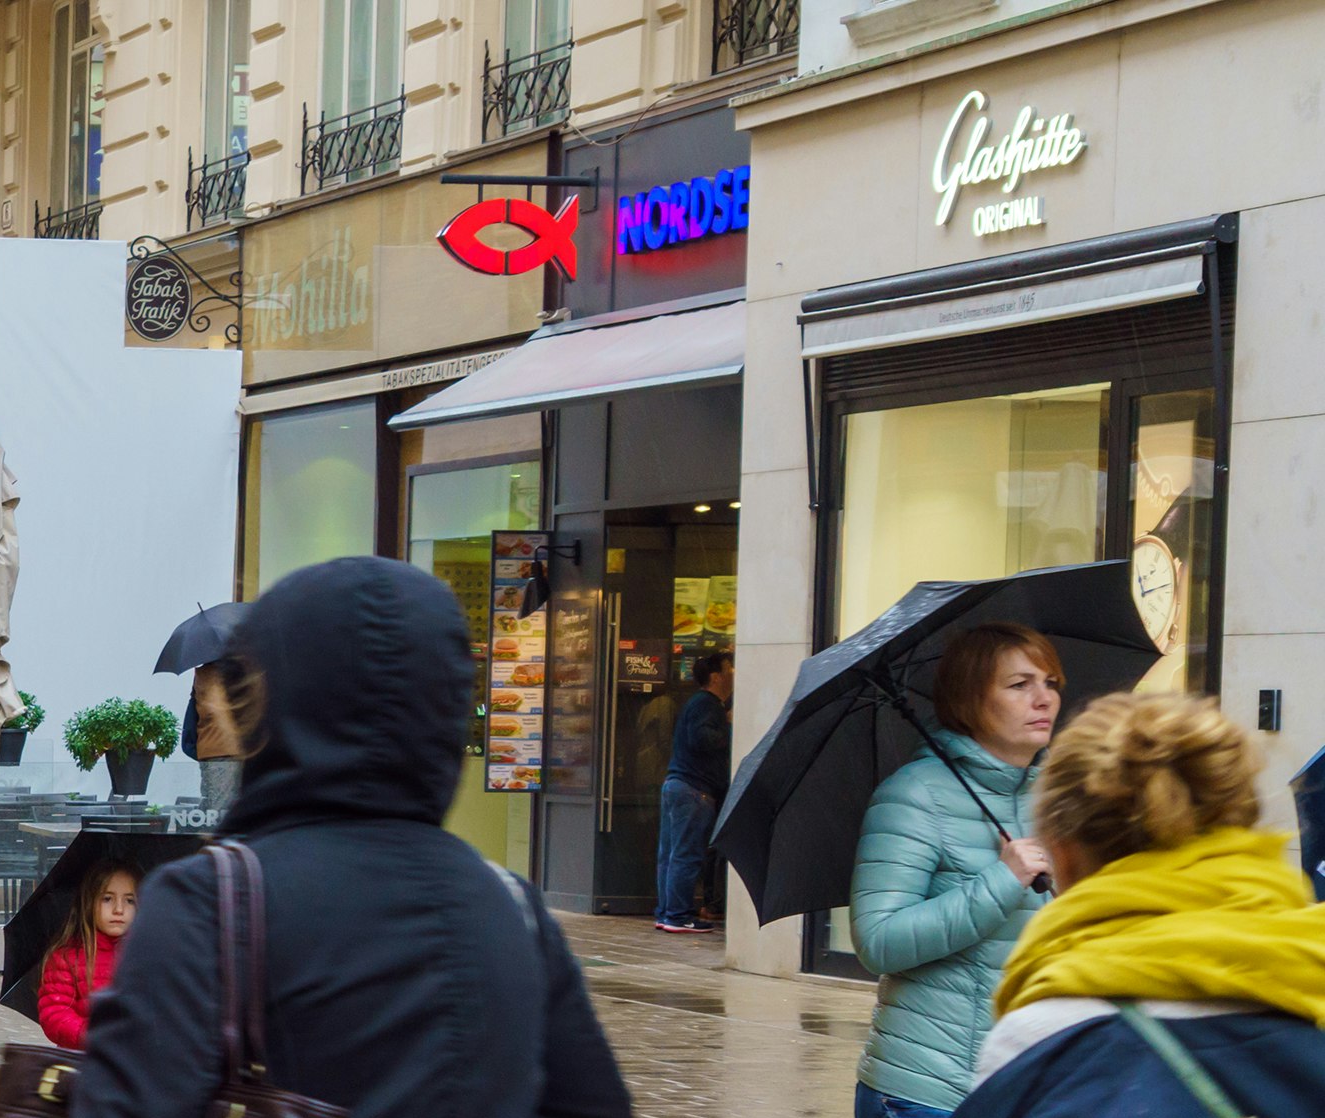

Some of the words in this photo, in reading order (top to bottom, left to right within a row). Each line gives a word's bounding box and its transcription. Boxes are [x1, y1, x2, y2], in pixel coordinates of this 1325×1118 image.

[932, 90, 1086, 226] Glashütte
[973, 196, 1042, 237] ORIGINAL
[131, 276, 187, 300] Tabak
[131, 299, 185, 325] Trafik
